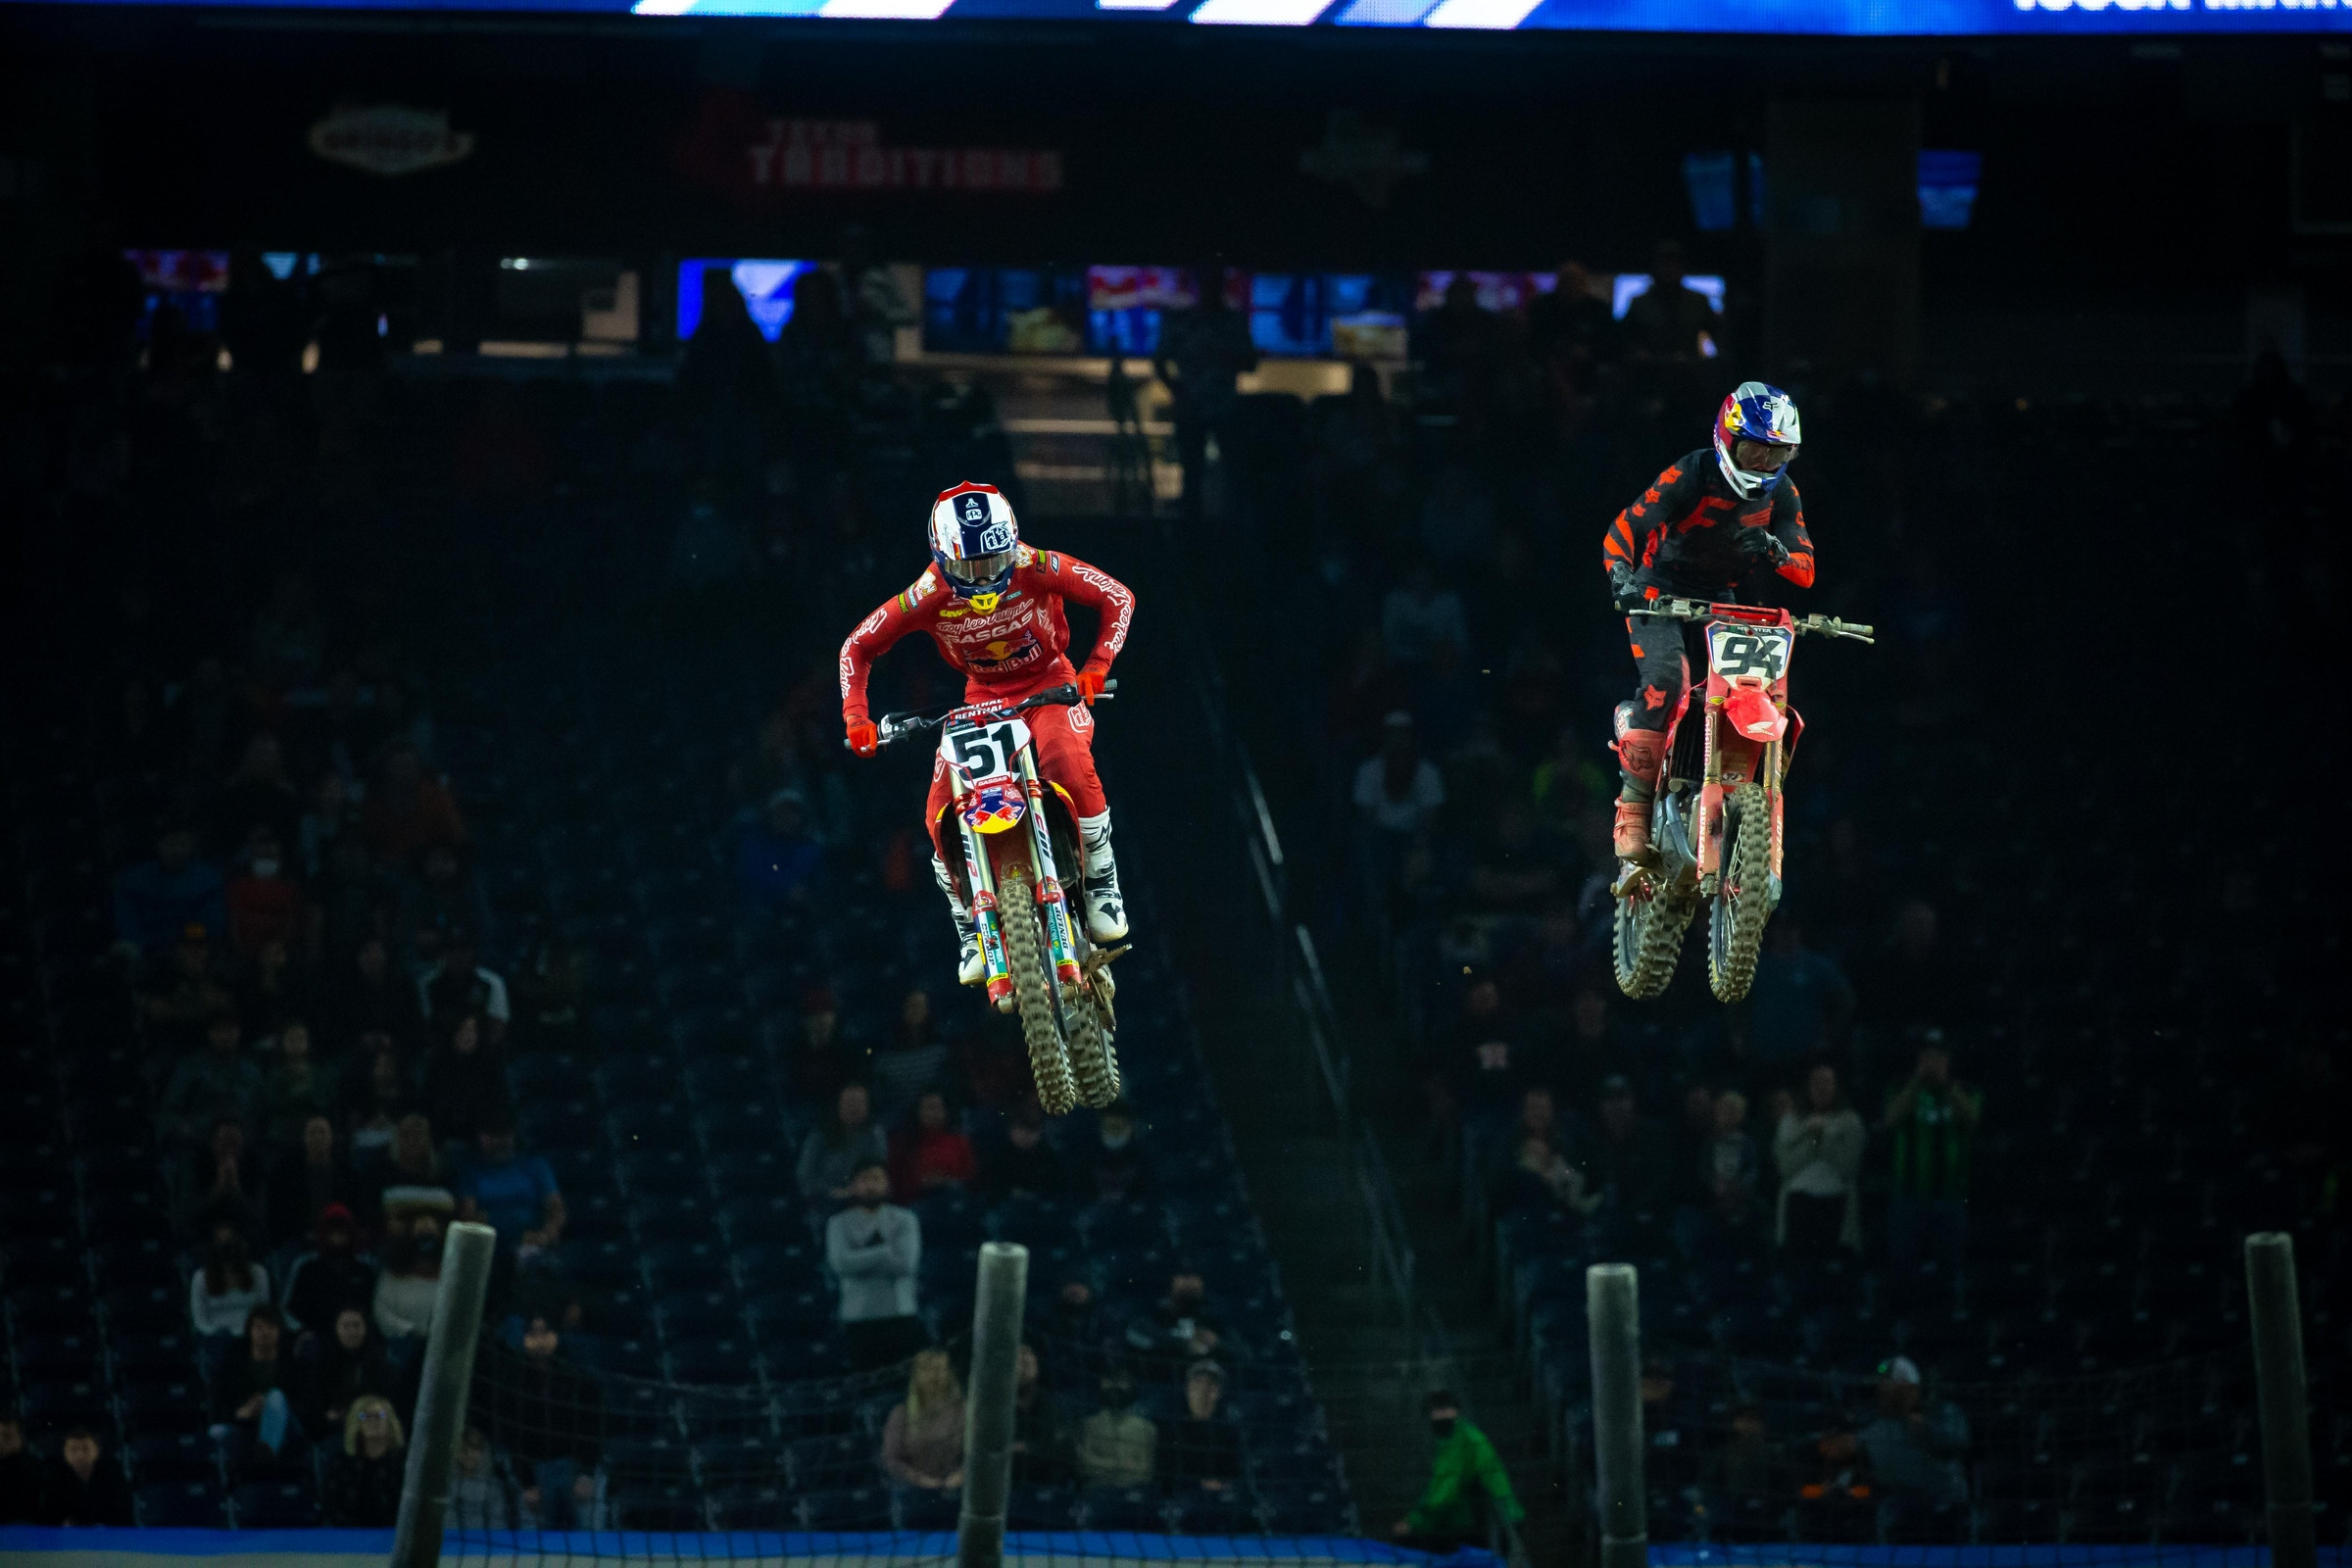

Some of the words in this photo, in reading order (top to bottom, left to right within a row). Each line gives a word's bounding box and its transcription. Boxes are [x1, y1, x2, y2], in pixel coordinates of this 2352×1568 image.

[962, 617, 987, 632] Lee
[1719, 637, 1782, 679] 94
[952, 723, 1020, 781] 51
[1054, 906, 1069, 950] DUNLOP
